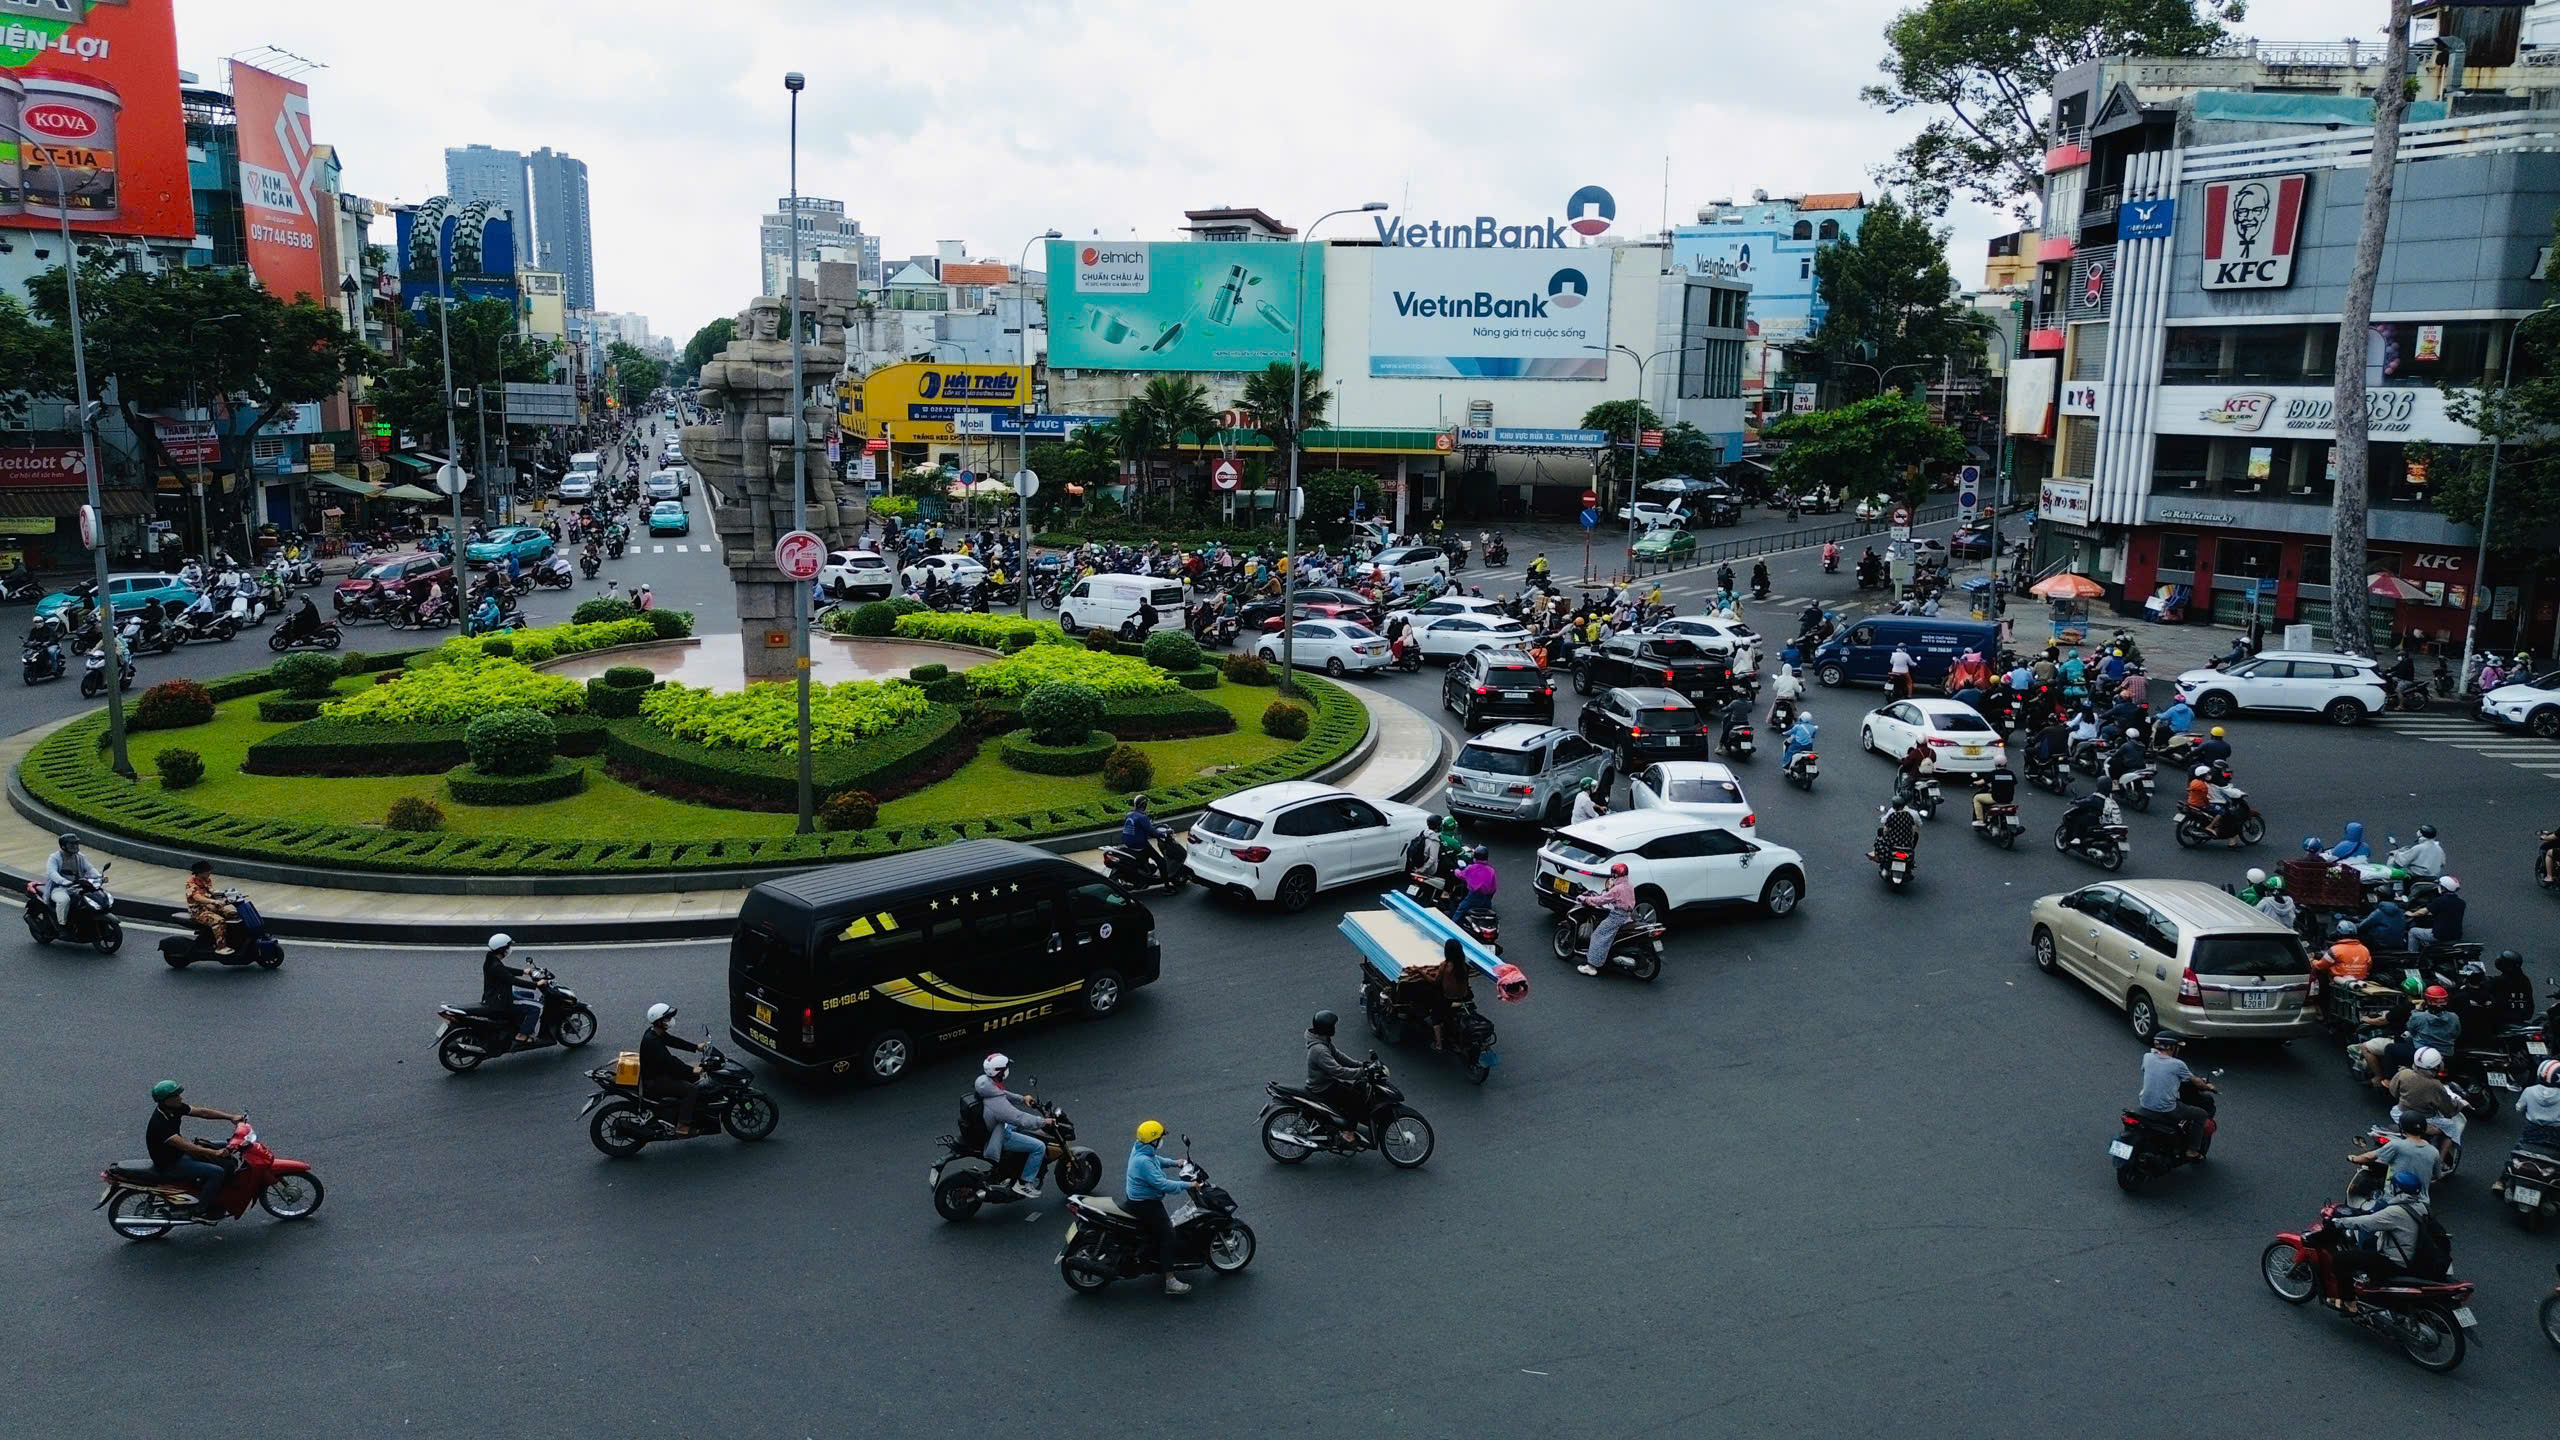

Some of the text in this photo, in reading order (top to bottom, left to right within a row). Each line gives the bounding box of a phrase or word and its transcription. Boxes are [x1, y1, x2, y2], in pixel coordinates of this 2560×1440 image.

[35, 112, 88, 132] KOVA
[262, 174, 281, 191] KIM
[263, 190, 293, 208] NGAN
[251, 223, 313, 249] 0977 44 55 88
[1373, 215, 1569, 248] VietinBank
[1101, 251, 1144, 264] elmich
[1696, 253, 1739, 278] VietinBank
[1110, 272, 1132, 281] CHÂU
[1133, 273, 1144, 281] ÂU
[2214, 259, 2277, 284] KFC
[1392, 291, 1549, 318] VietinBank
[1473, 326, 1586, 339] Nâng giá trị cuộc sống
[2223, 399, 2261, 413] KFC
[2286, 399, 2332, 419] 1900
[960, 420, 984, 428] Mobil
[1034, 418, 1059, 431] VỰC
[1461, 429, 1489, 440] Mobil
[1561, 433, 1578, 441] THAY
[2160, 509, 2171, 517] Gà
[2192, 511, 2234, 524] Kentucky
[2413, 553, 2462, 571] KFC
[983, 1003, 1053, 1033] HIACE
[938, 1028, 967, 1041] TOYOTA
